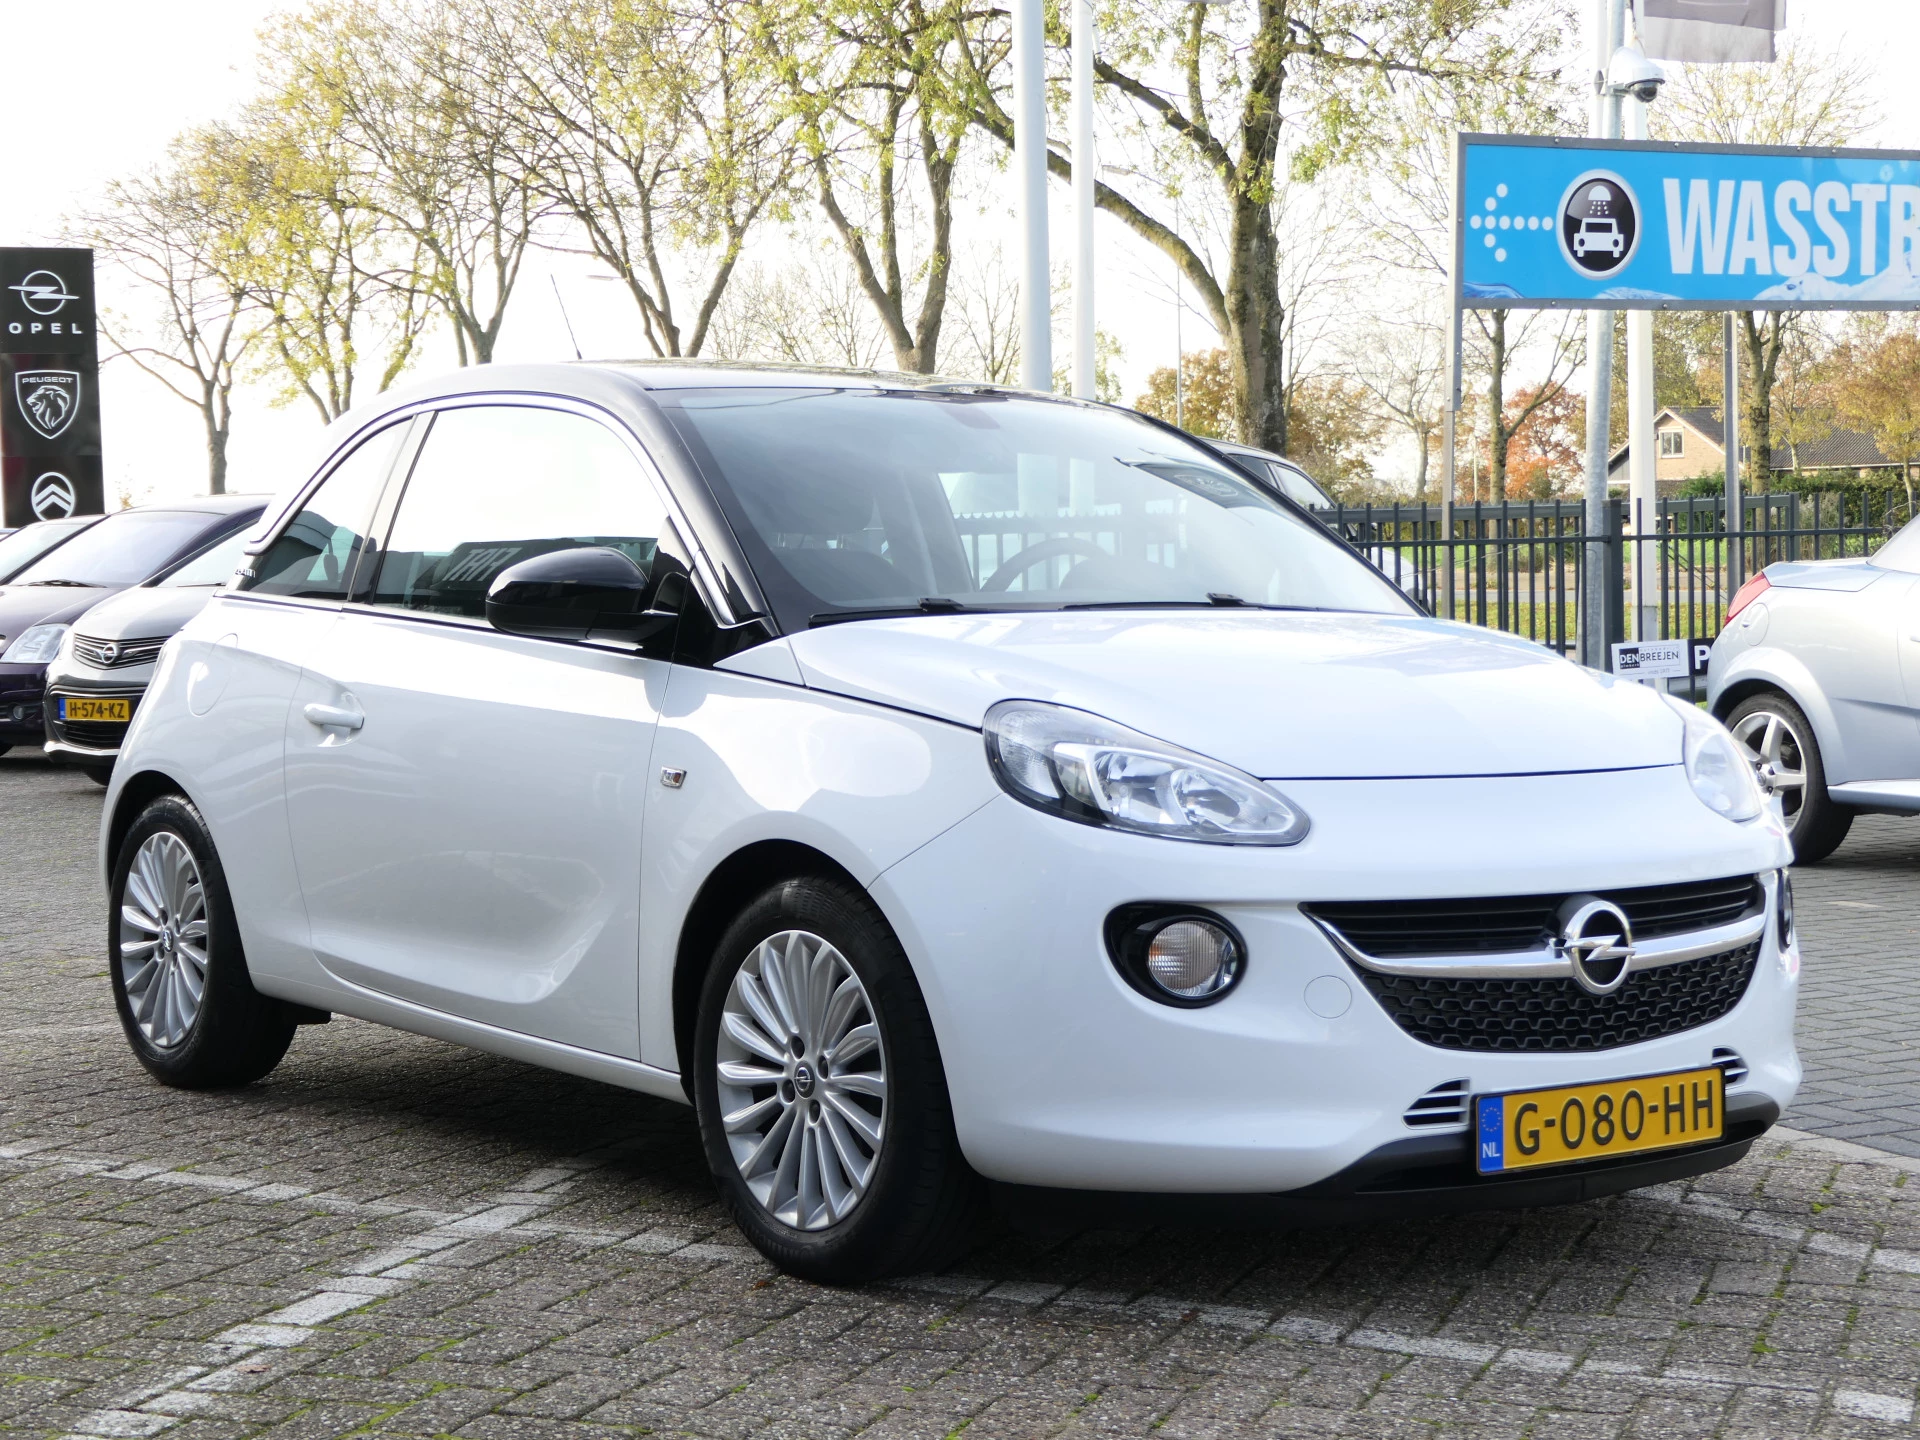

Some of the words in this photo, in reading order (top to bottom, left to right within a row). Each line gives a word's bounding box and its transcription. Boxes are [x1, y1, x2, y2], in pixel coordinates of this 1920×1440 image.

[1662, 177, 1920, 277] WASSTR
[8, 322, 83, 335] OPEL
[22, 376, 74, 384] PEUGEOT
[1620, 651, 1640, 664] DEN
[1640, 651, 1680, 662] BREEJEN
[69, 702, 125, 718] H-574-KZ
[1514, 1079, 1714, 1156] G-080-HH
[1481, 1141, 1501, 1159] NL
